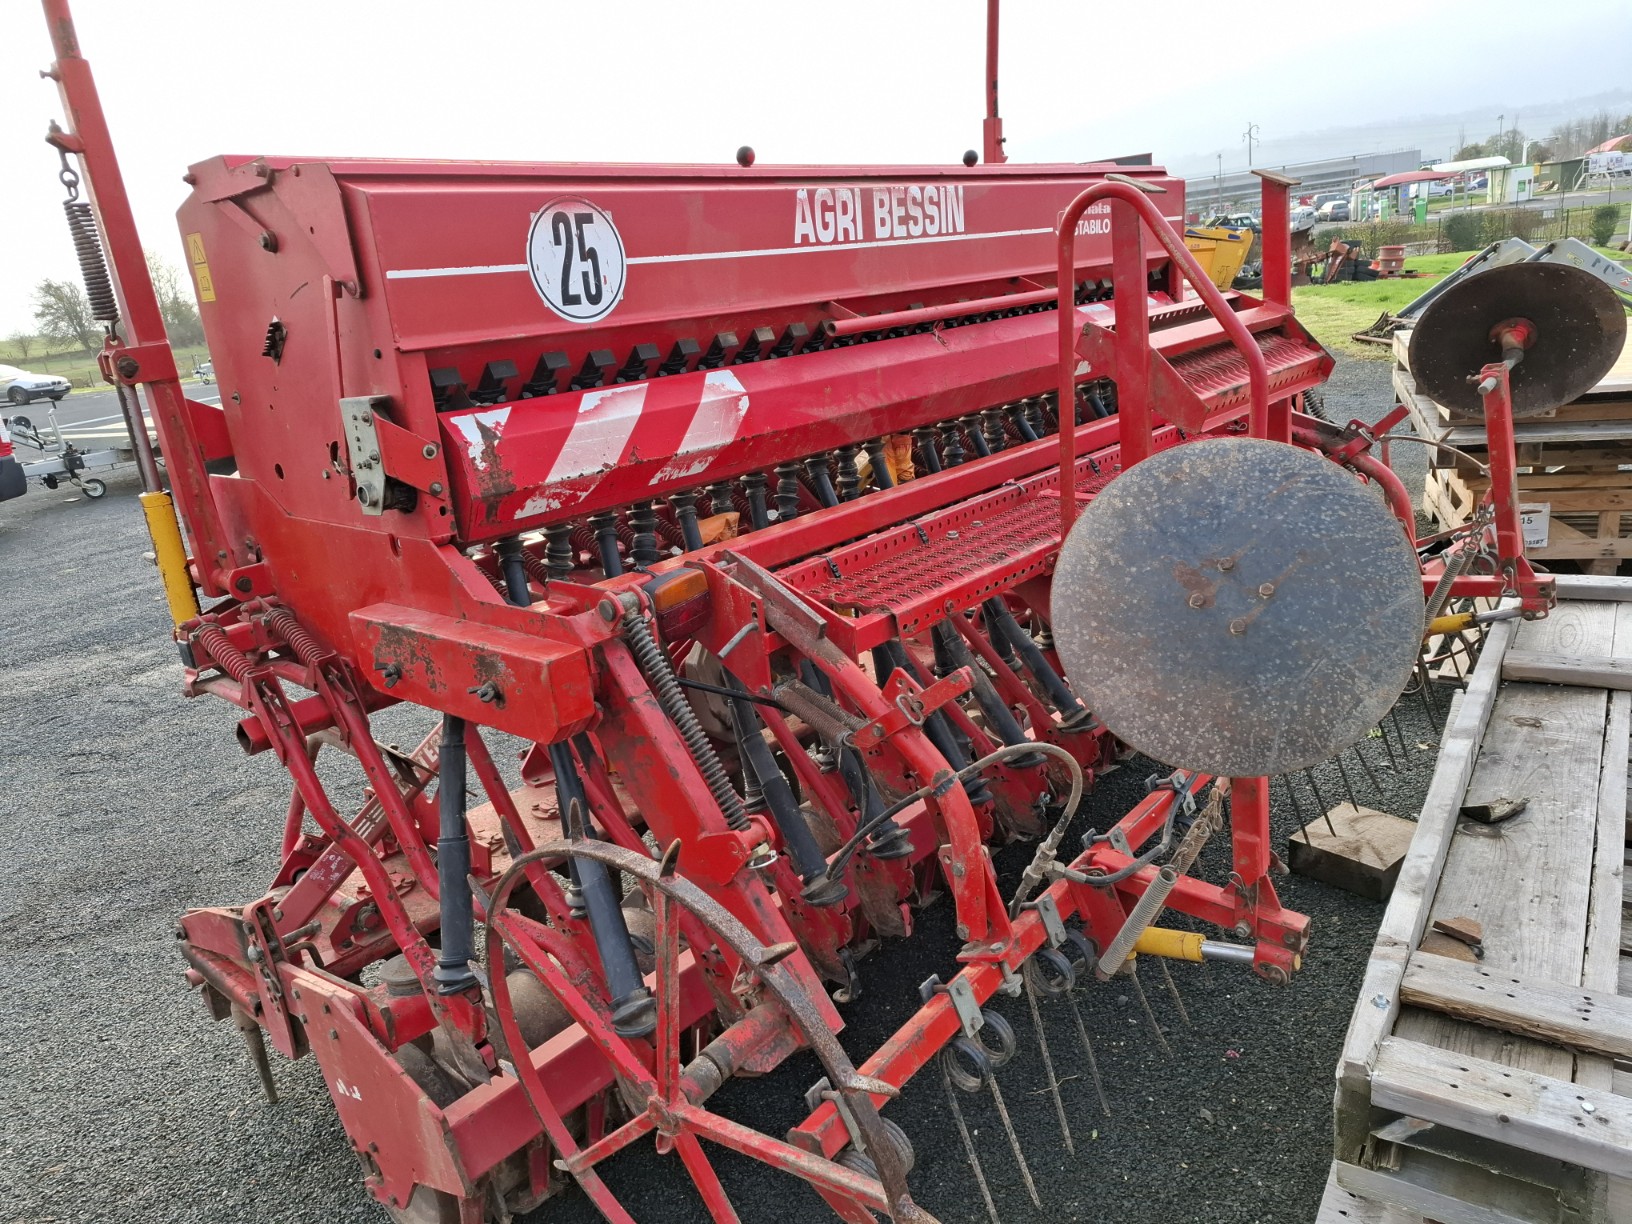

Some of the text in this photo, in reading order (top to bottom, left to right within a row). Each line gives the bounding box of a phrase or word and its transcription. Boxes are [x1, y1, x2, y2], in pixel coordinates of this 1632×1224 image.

[794, 185, 965, 243] AGRI BESSIN
[552, 211, 603, 306] 25
